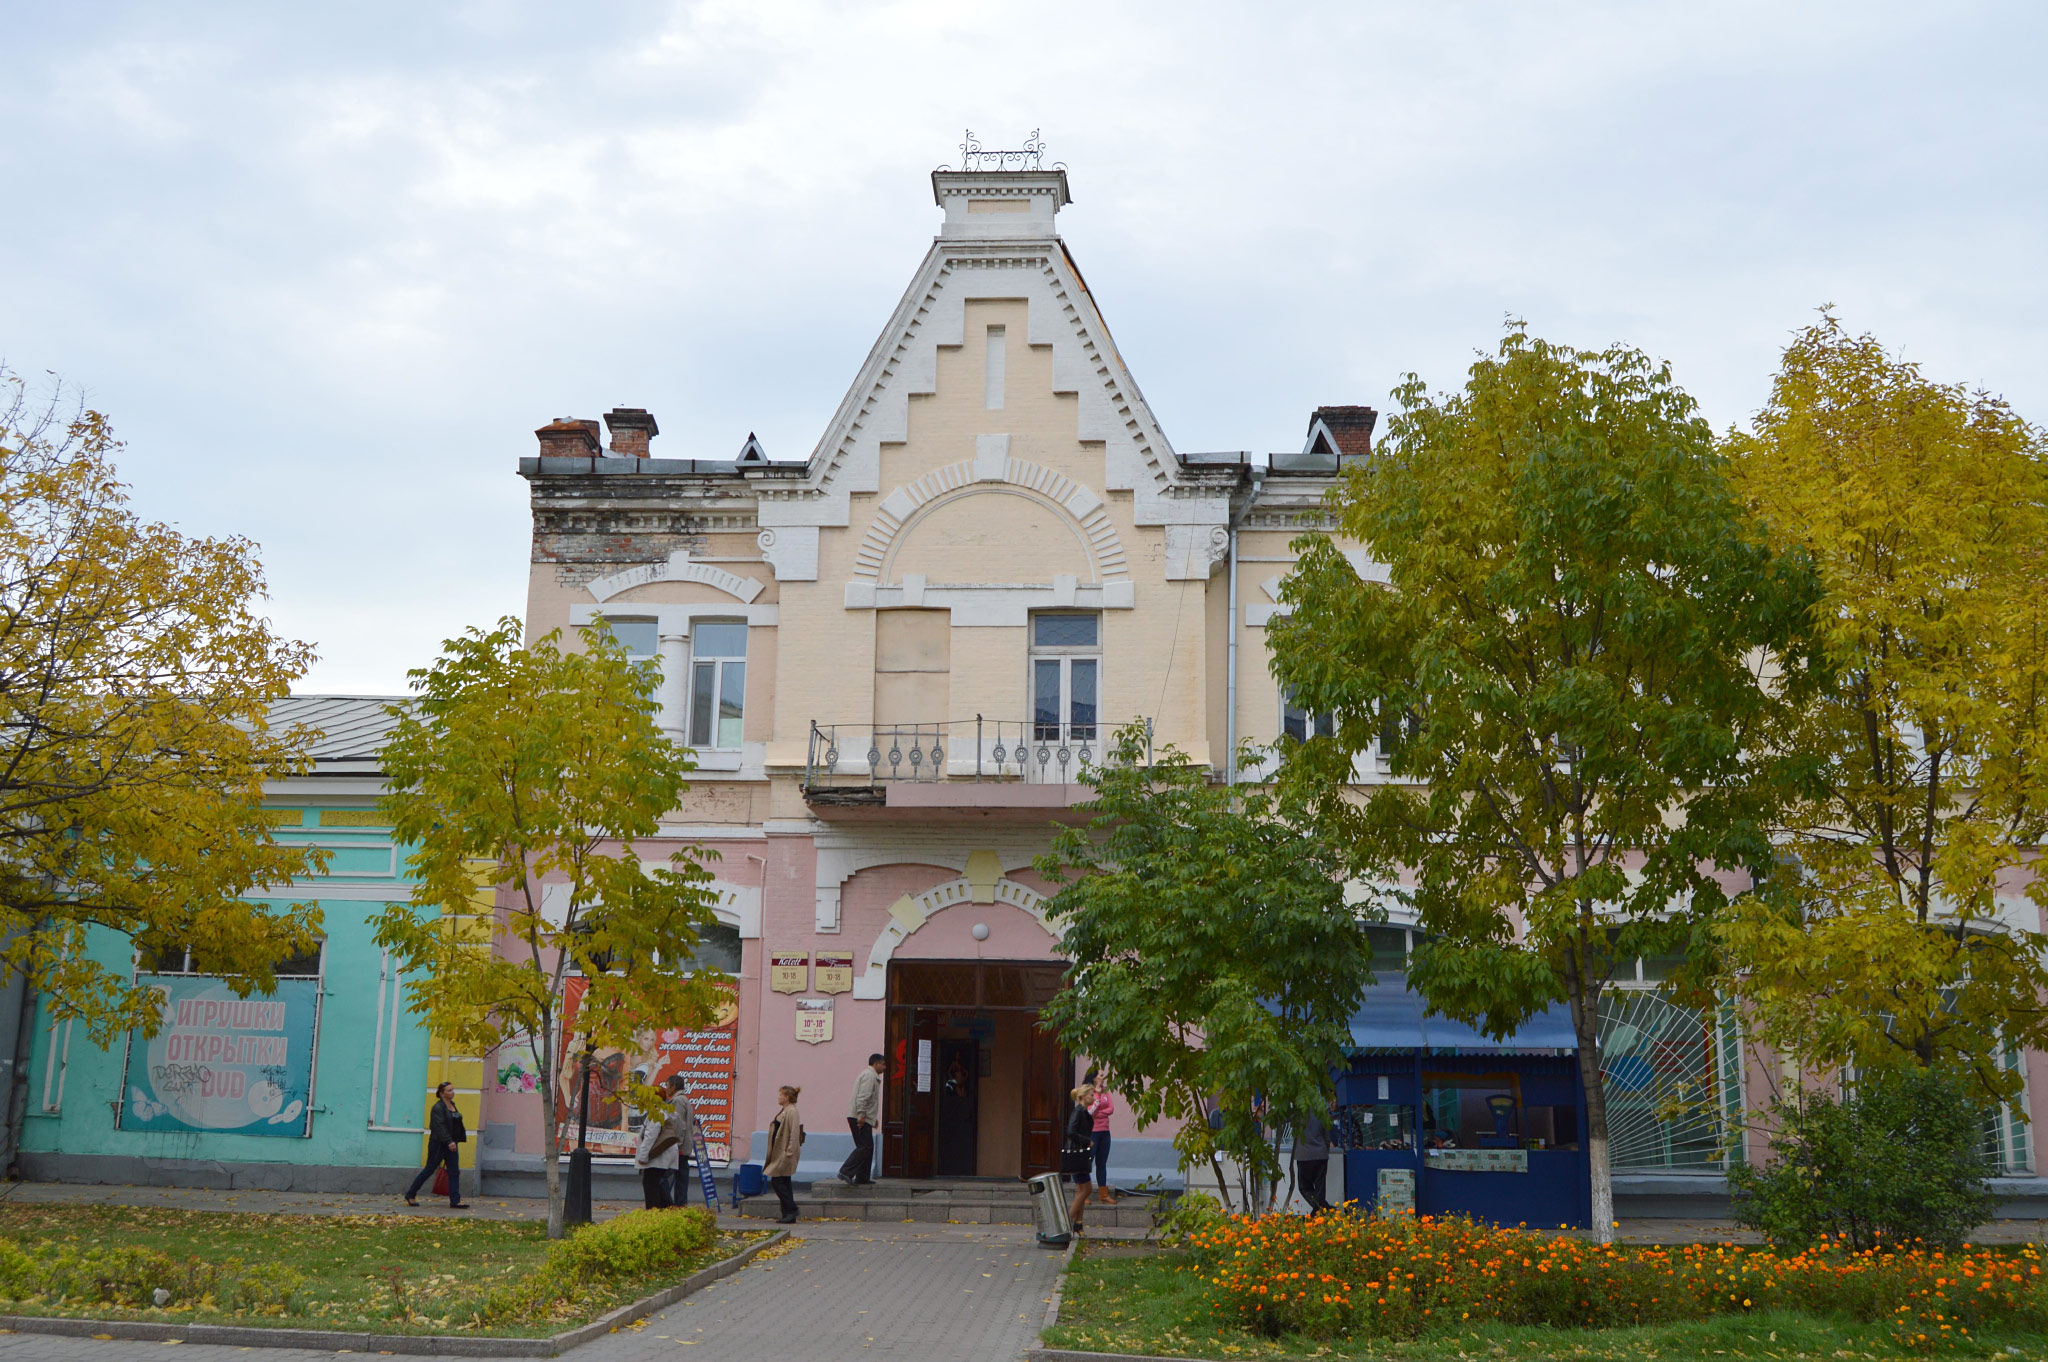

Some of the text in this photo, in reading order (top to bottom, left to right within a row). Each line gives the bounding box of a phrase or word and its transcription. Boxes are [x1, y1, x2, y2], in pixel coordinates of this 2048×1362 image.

[177, 999, 286, 1031] ИГРУШКИ
[682, 1031, 732, 1043] мужское
[167, 1034, 288, 1067] ОТКРЫТКИ
[658, 1039, 731, 1052] женское белье
[684, 1054, 730, 1069] корсеты
[677, 1070, 729, 1079] костюмы
[201, 1070, 246, 1099] DVD
[688, 1095, 728, 1110] сорочки
[693, 1112, 726, 1124] чулки
